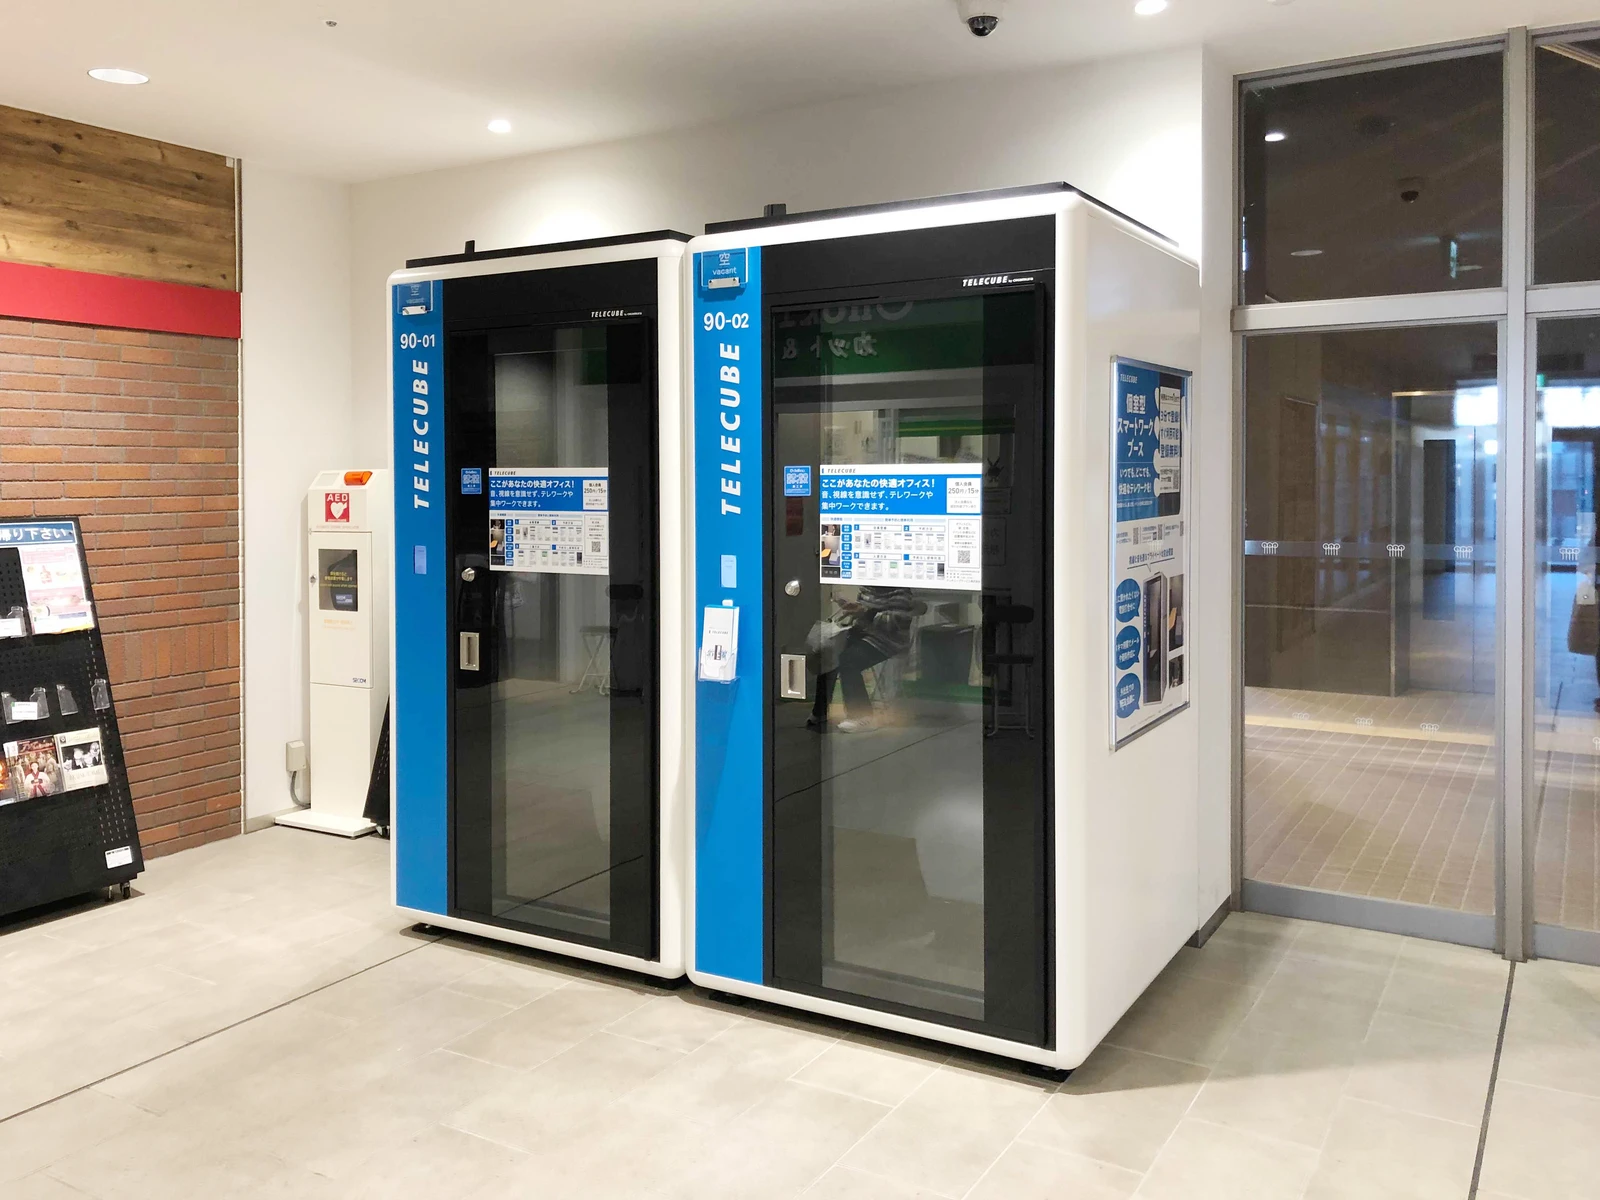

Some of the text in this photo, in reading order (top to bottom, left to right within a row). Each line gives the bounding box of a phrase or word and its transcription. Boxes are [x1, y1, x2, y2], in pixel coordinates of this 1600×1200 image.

[718, 252, 731, 266] 空
[712, 267, 737, 275] vacant
[962, 275, 1008, 287] TELECUBE
[591, 310, 624, 318] TELECUBE
[703, 311, 750, 331] 90-02
[400, 332, 435, 349] 90-01
[1119, 373, 1138, 384] TELECUBE
[1125, 392, 1147, 415] 個室型
[720, 342, 741, 516] TELECUBE
[1117, 416, 1154, 437] スマートワーク
[412, 359, 430, 509] TELECUBE
[1127, 439, 1144, 458] ブース
[326, 493, 349, 502] AED
[490, 489, 574, 499] 音、視線を意識せず、テレワークや
[821, 489, 934, 500] 音、視線を意識せず、テレワークや
[490, 499, 541, 508] 集中ワークできます。
[821, 501, 890, 511] 集中ワークできます。
